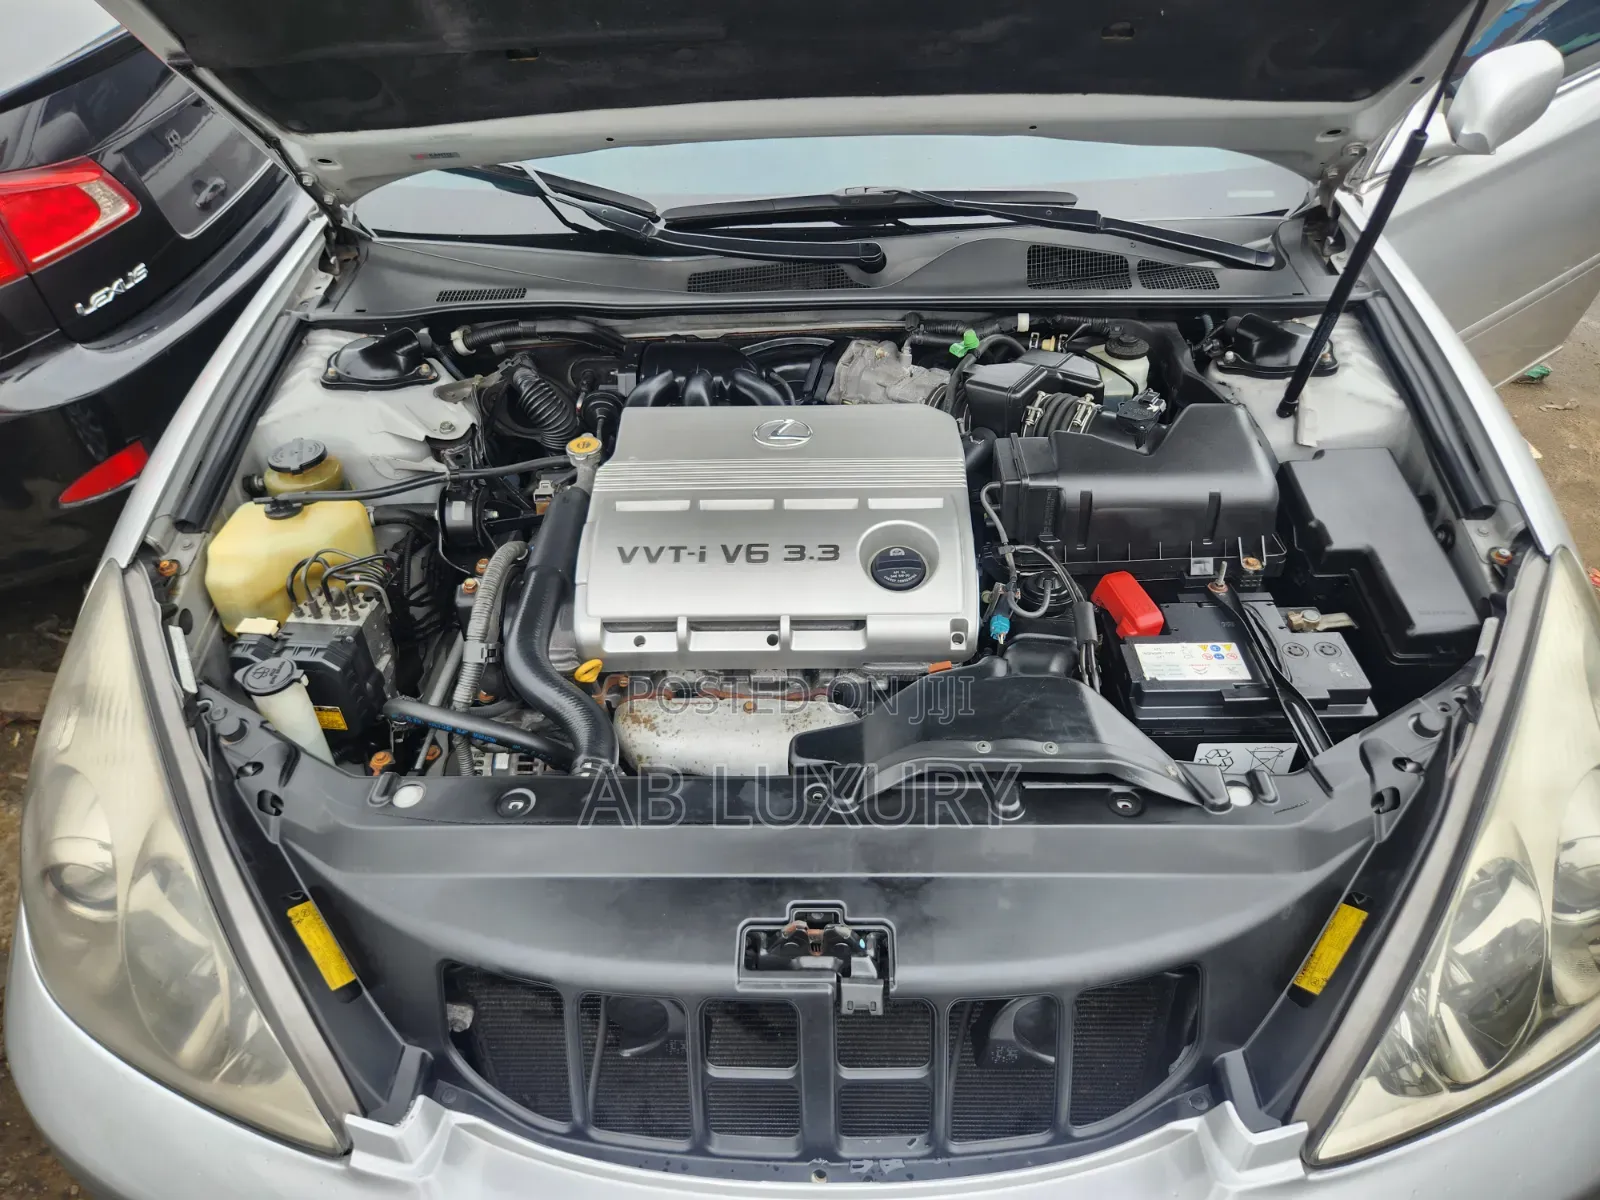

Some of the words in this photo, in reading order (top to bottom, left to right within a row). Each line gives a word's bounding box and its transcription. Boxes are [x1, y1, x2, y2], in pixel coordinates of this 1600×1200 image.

[75, 262, 148, 316] LEXUS
[617, 545, 707, 563] VVT-i
[720, 543, 769, 563] V6
[783, 544, 840, 562] 3.3
